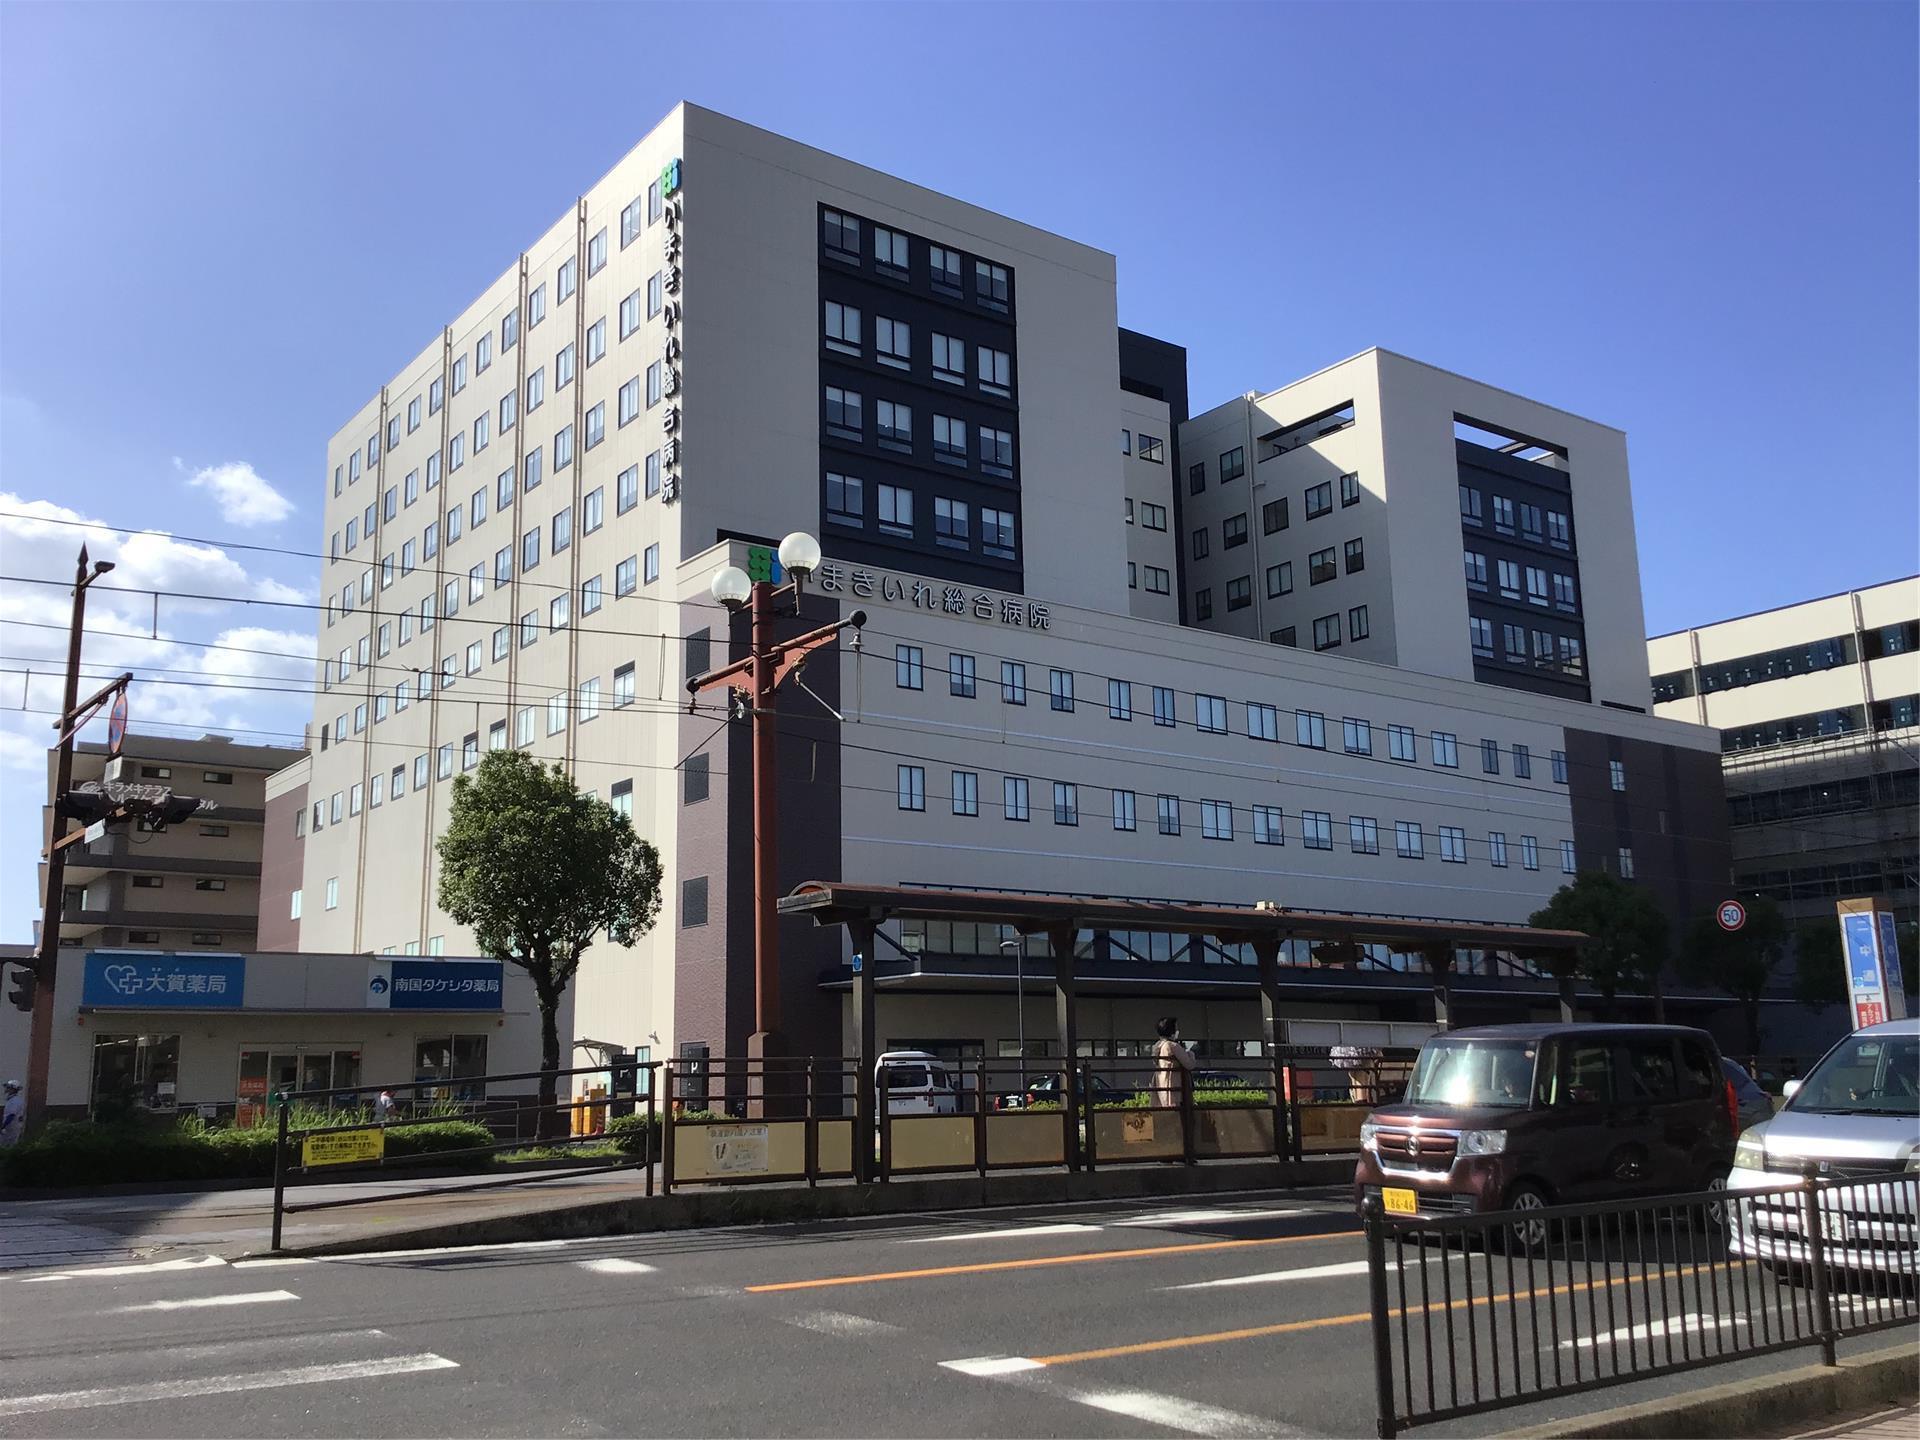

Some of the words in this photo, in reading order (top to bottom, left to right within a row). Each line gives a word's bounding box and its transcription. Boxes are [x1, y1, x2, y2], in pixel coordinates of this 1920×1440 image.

[661, 200, 681, 504] いまきいれ総合病院
[104, 782, 172, 796] キラメキテラス
[1724, 909, 1739, 922] 50
[145, 974, 226, 993] 大賀薬局
[395, 978, 499, 992] 南国タケシタ薬局
